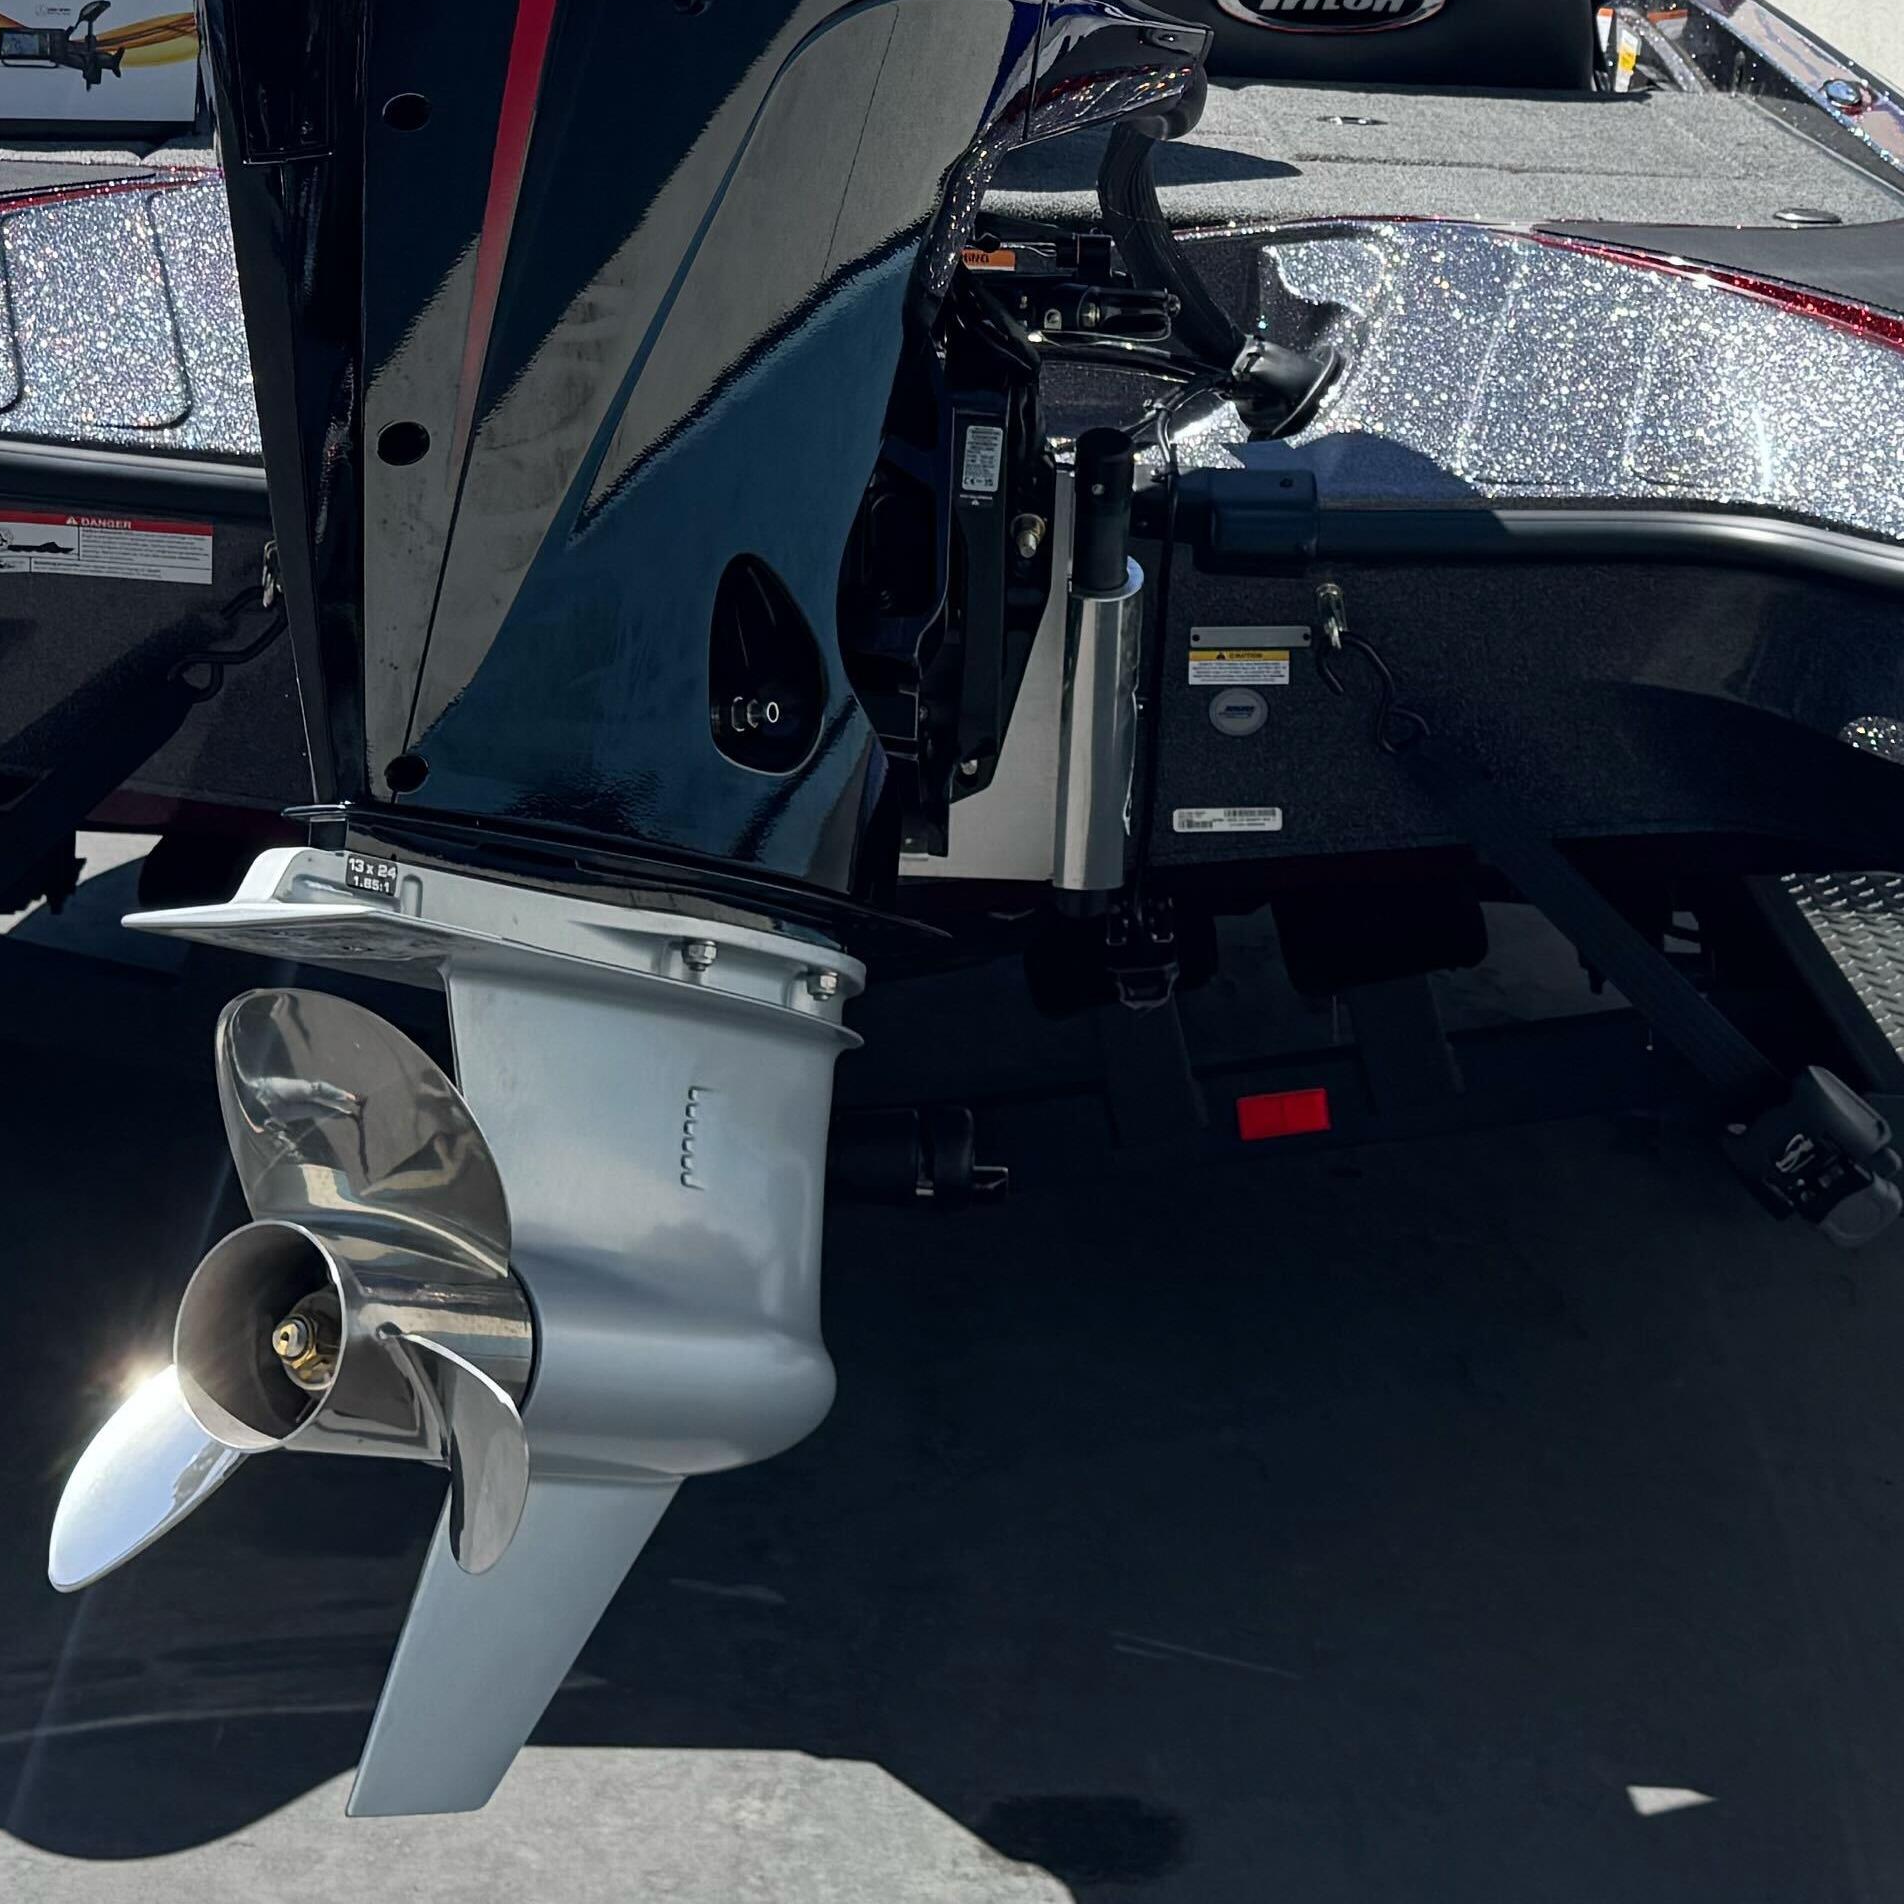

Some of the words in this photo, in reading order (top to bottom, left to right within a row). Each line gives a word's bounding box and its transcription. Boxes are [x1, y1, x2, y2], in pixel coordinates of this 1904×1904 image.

[81, 518, 132, 529] DANGER
[349, 858, 364, 872] 13
[366, 864, 374, 875] x
[378, 864, 396, 879] 24
